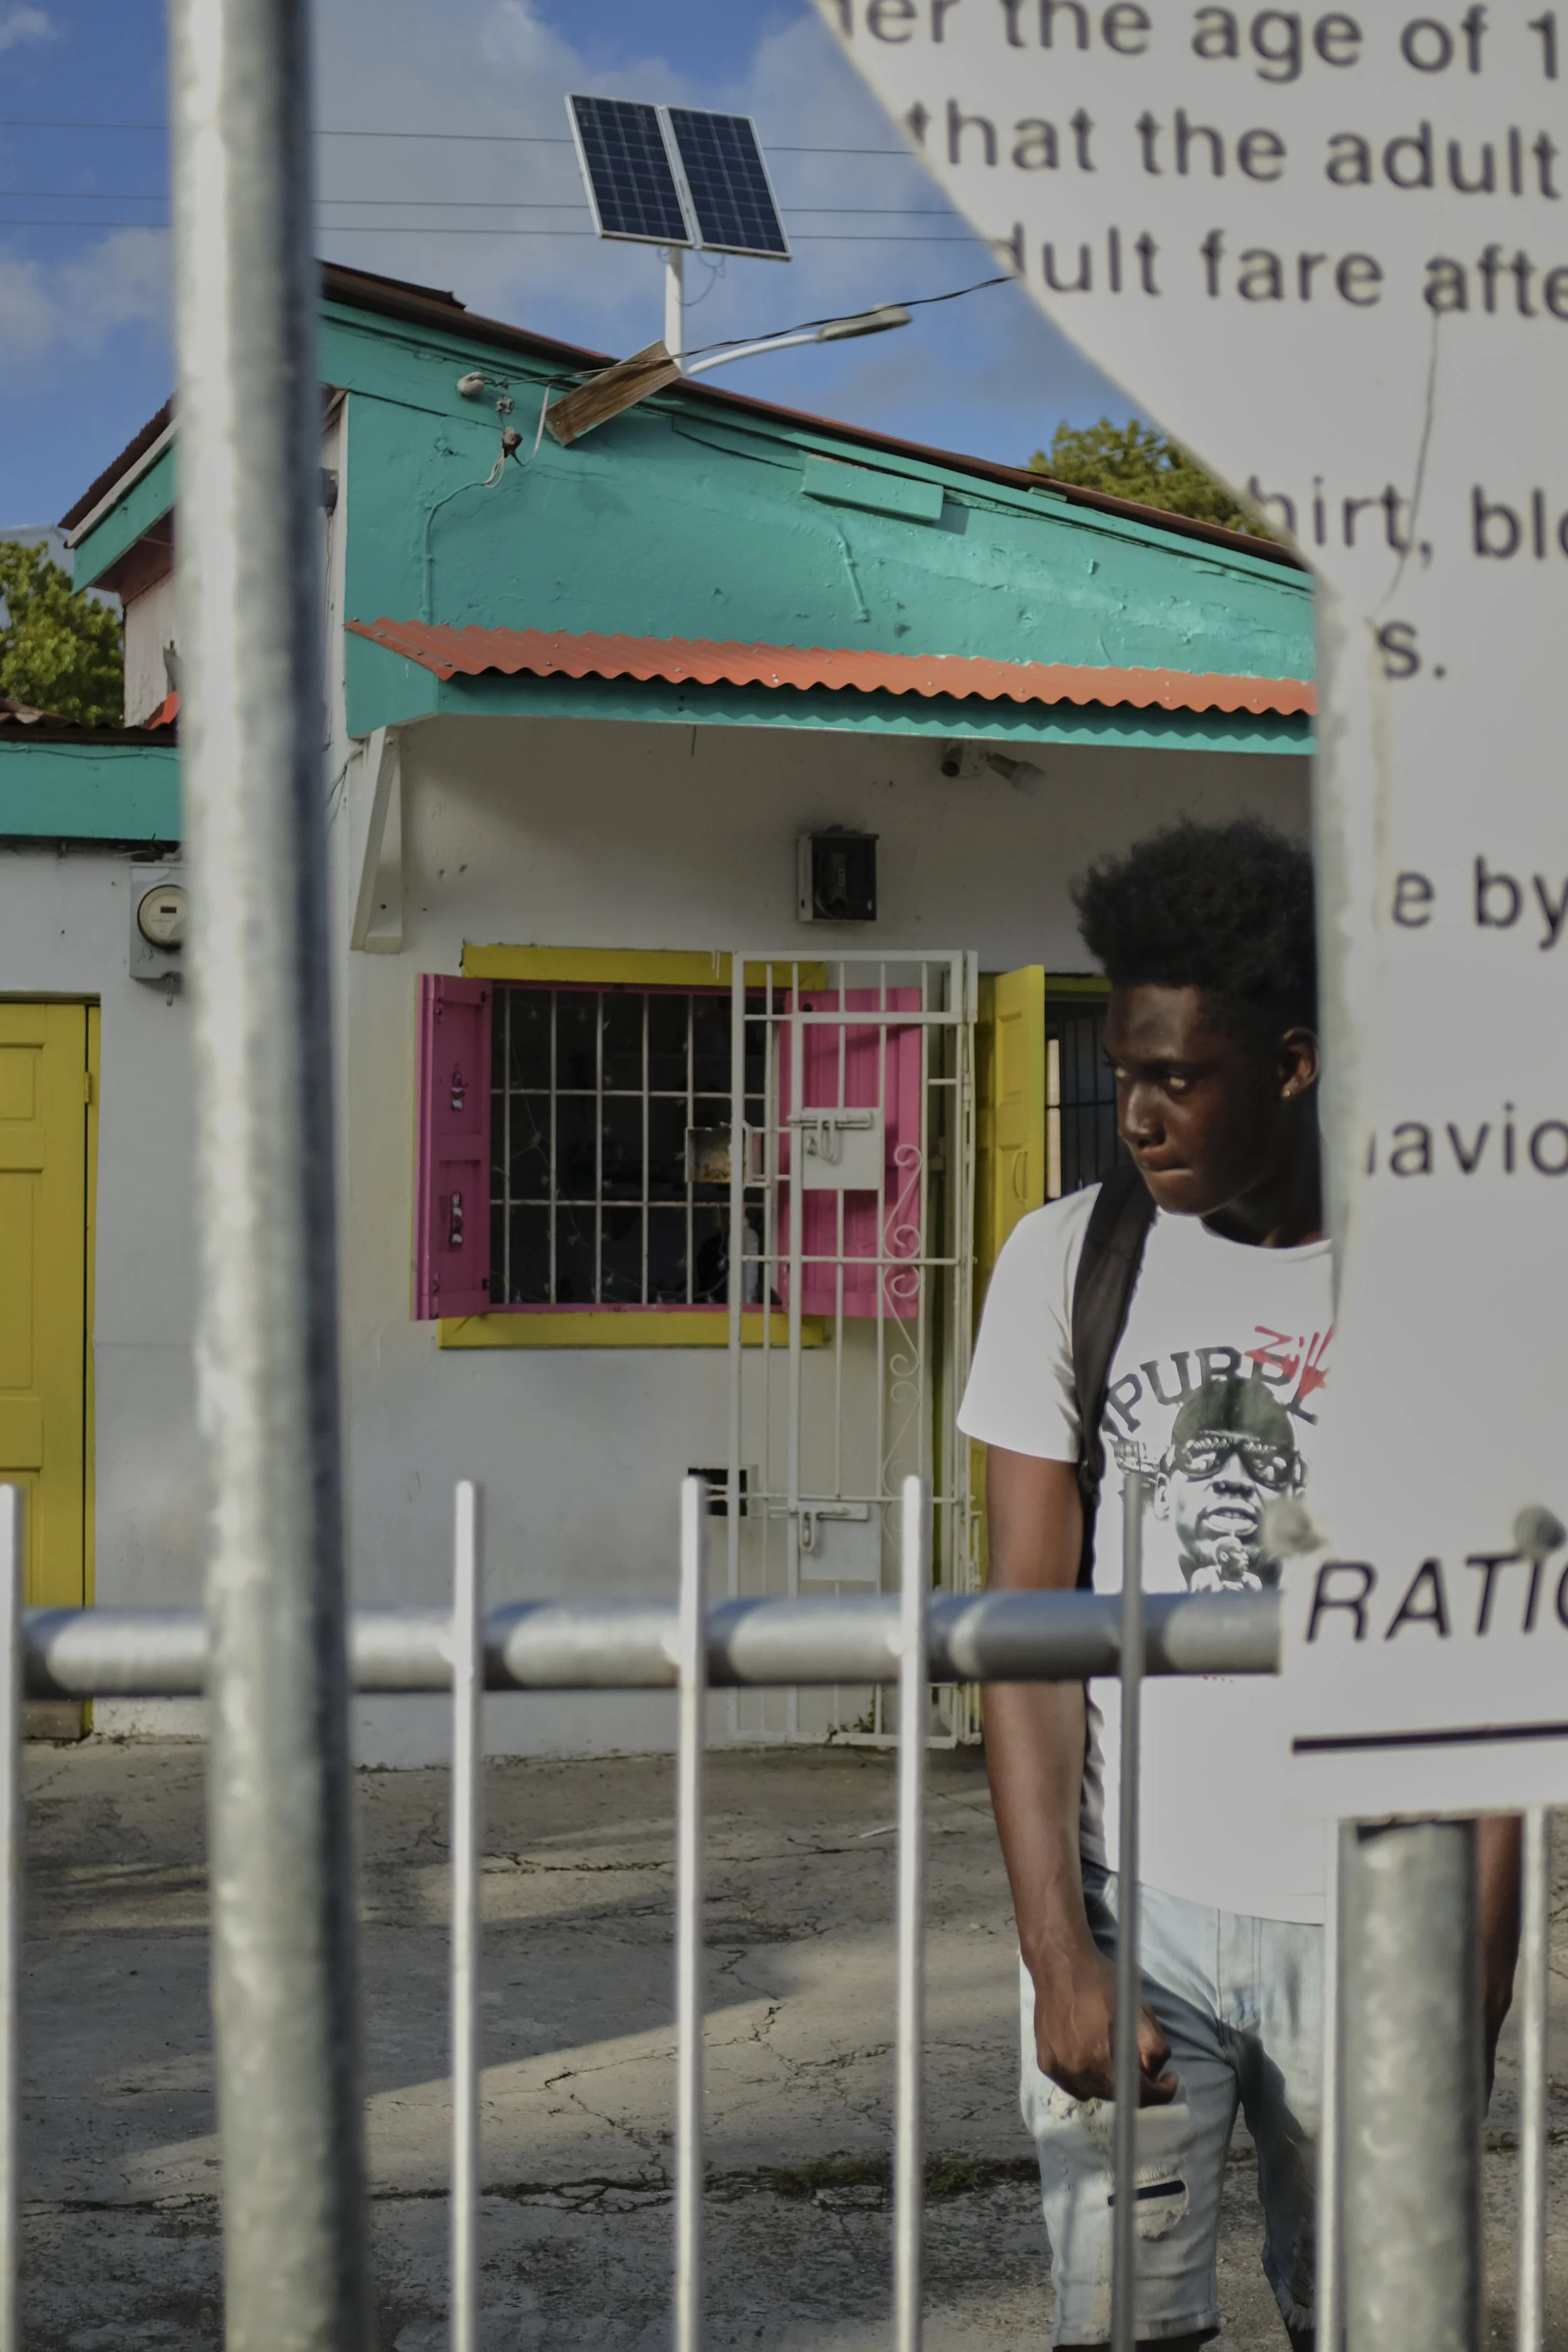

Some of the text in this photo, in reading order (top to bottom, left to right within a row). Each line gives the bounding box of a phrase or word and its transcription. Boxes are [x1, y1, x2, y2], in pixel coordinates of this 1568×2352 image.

[999, 0, 1153, 56] the
[1190, 5, 1364, 85] age
[1399, 3, 1488, 75] of
[1135, 107, 1288, 183] the
[1324, 119, 1562, 201] adult
[1199, 228, 1385, 308] fare
[1473, 854, 1568, 953] by
[1364, 1101, 1568, 1179] avio
[1305, 1553, 1568, 1645] RATI
